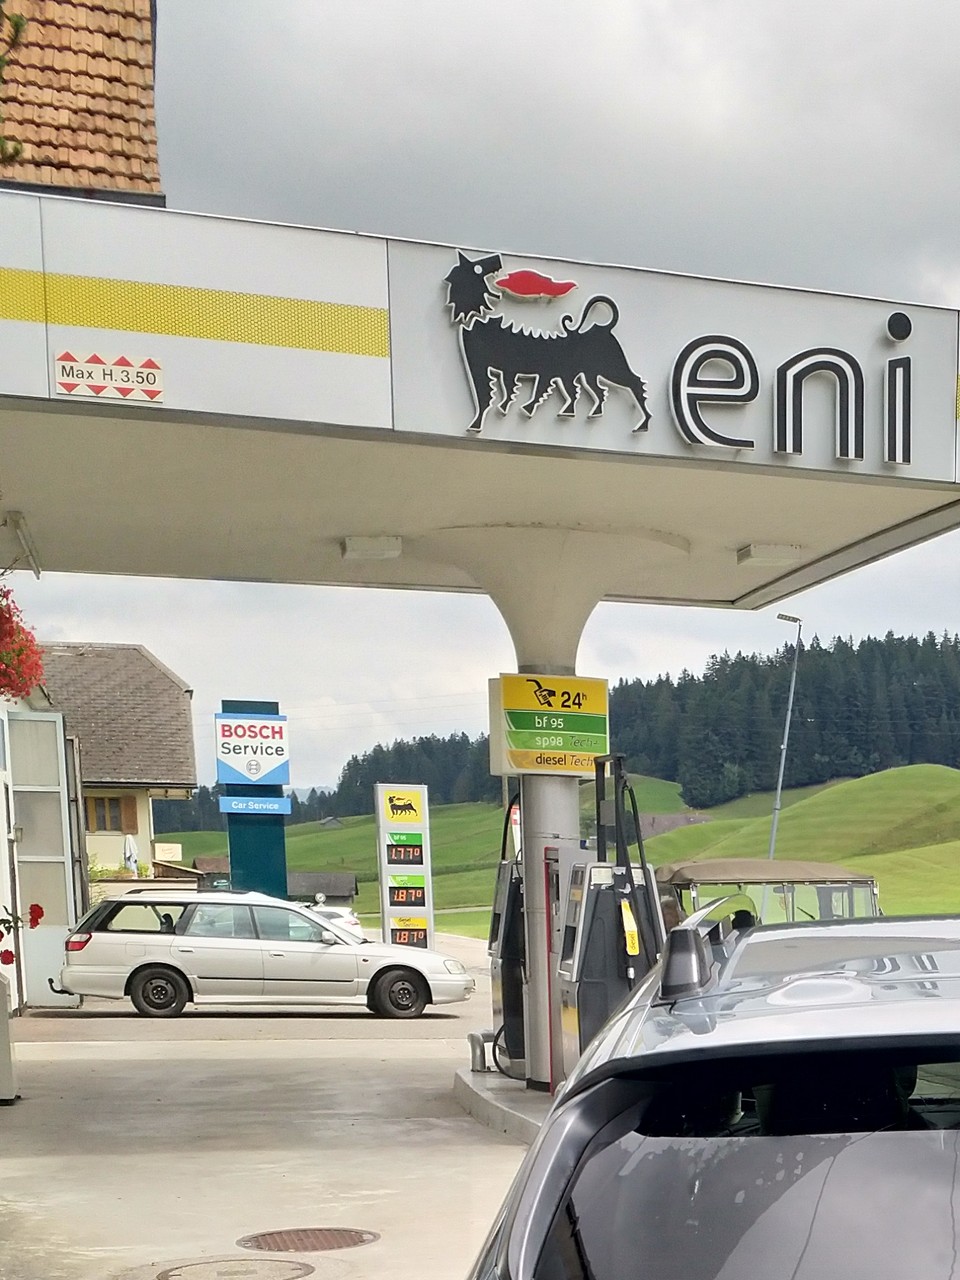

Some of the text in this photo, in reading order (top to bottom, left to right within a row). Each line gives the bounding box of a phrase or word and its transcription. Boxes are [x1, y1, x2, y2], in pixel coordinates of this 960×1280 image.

[61, 364, 95, 380] Max
[669, 310, 913, 465] eni
[535, 715, 564, 729] bf 95
[221, 724, 284, 740] BOSCH
[220, 741, 285, 757] Service
[535, 736, 564, 749] sp98
[535, 753, 594, 768] diesel Tech
[231, 801, 280, 811] Car Service
